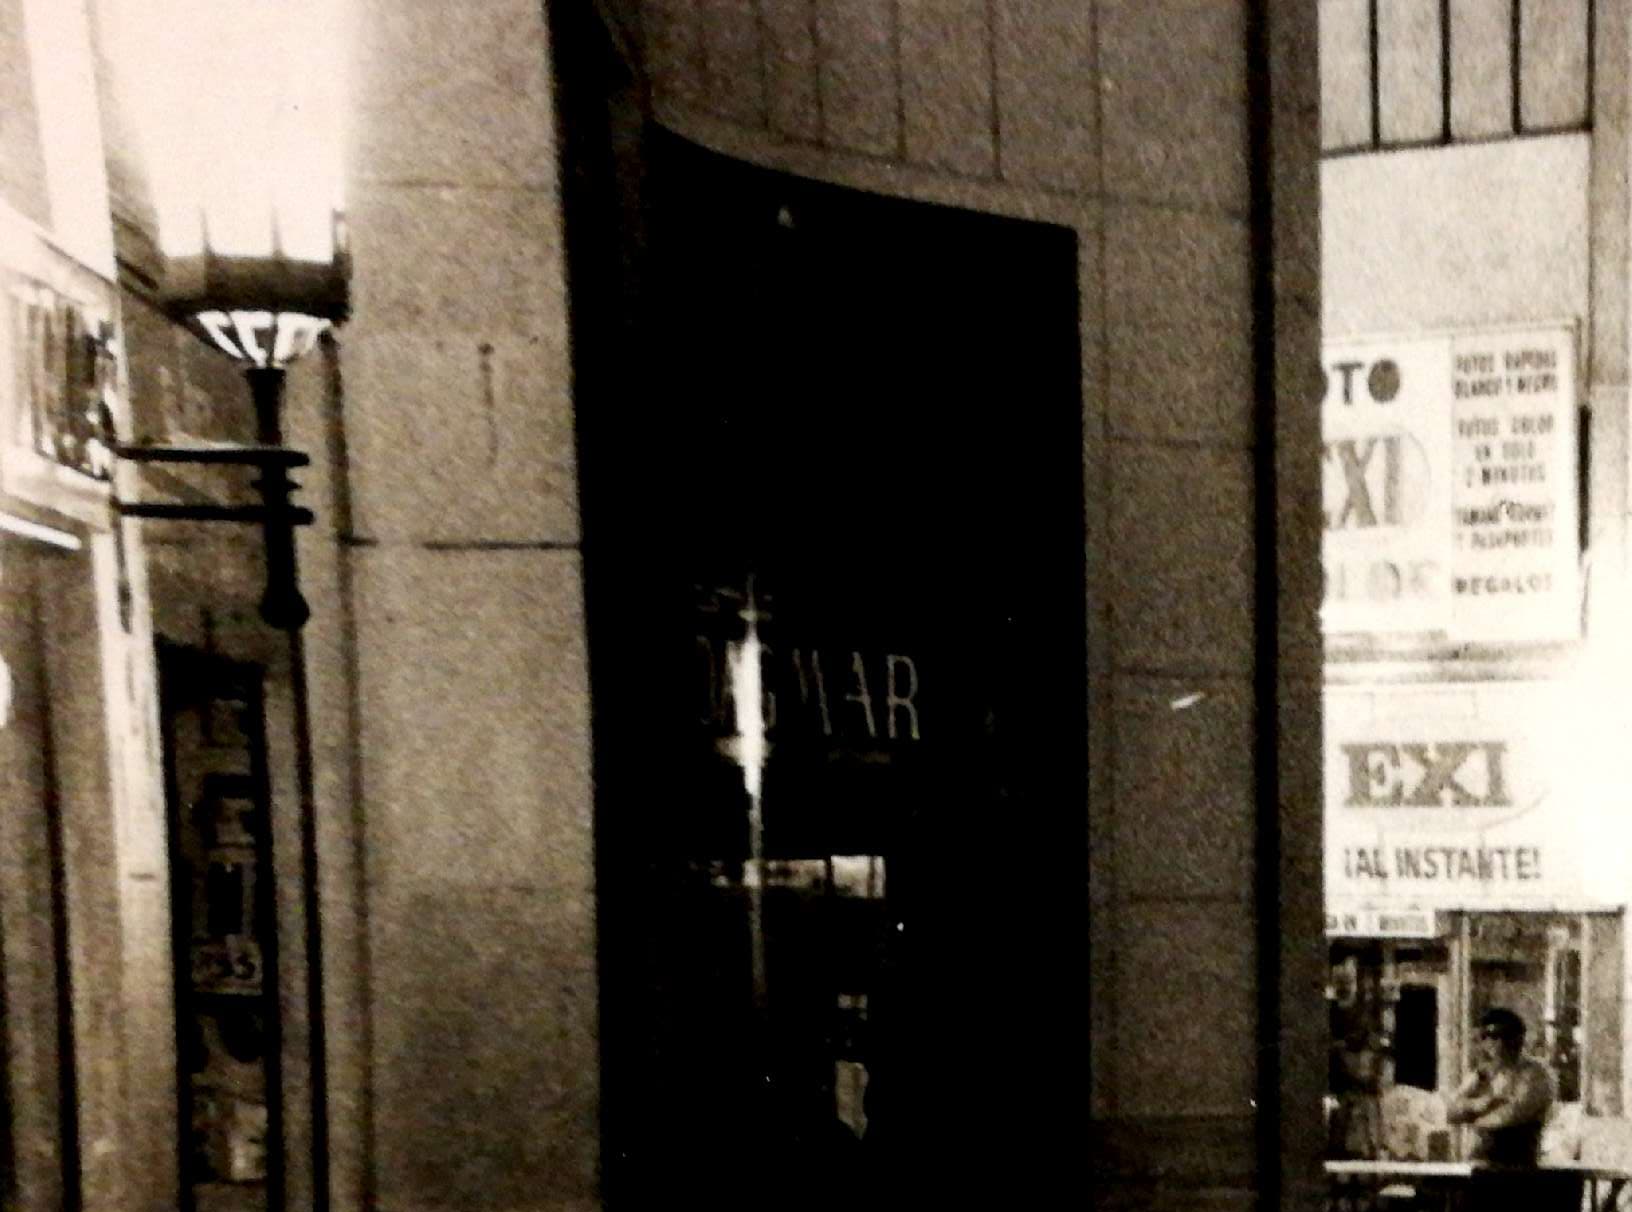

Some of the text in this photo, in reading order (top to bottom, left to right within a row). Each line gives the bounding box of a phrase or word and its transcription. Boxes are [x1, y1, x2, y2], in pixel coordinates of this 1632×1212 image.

[1323, 357, 1400, 406] TO
[1323, 435, 1401, 531] XI
[1338, 740, 1515, 809] EXI
[1395, 845, 1543, 881] INSTANTE!
